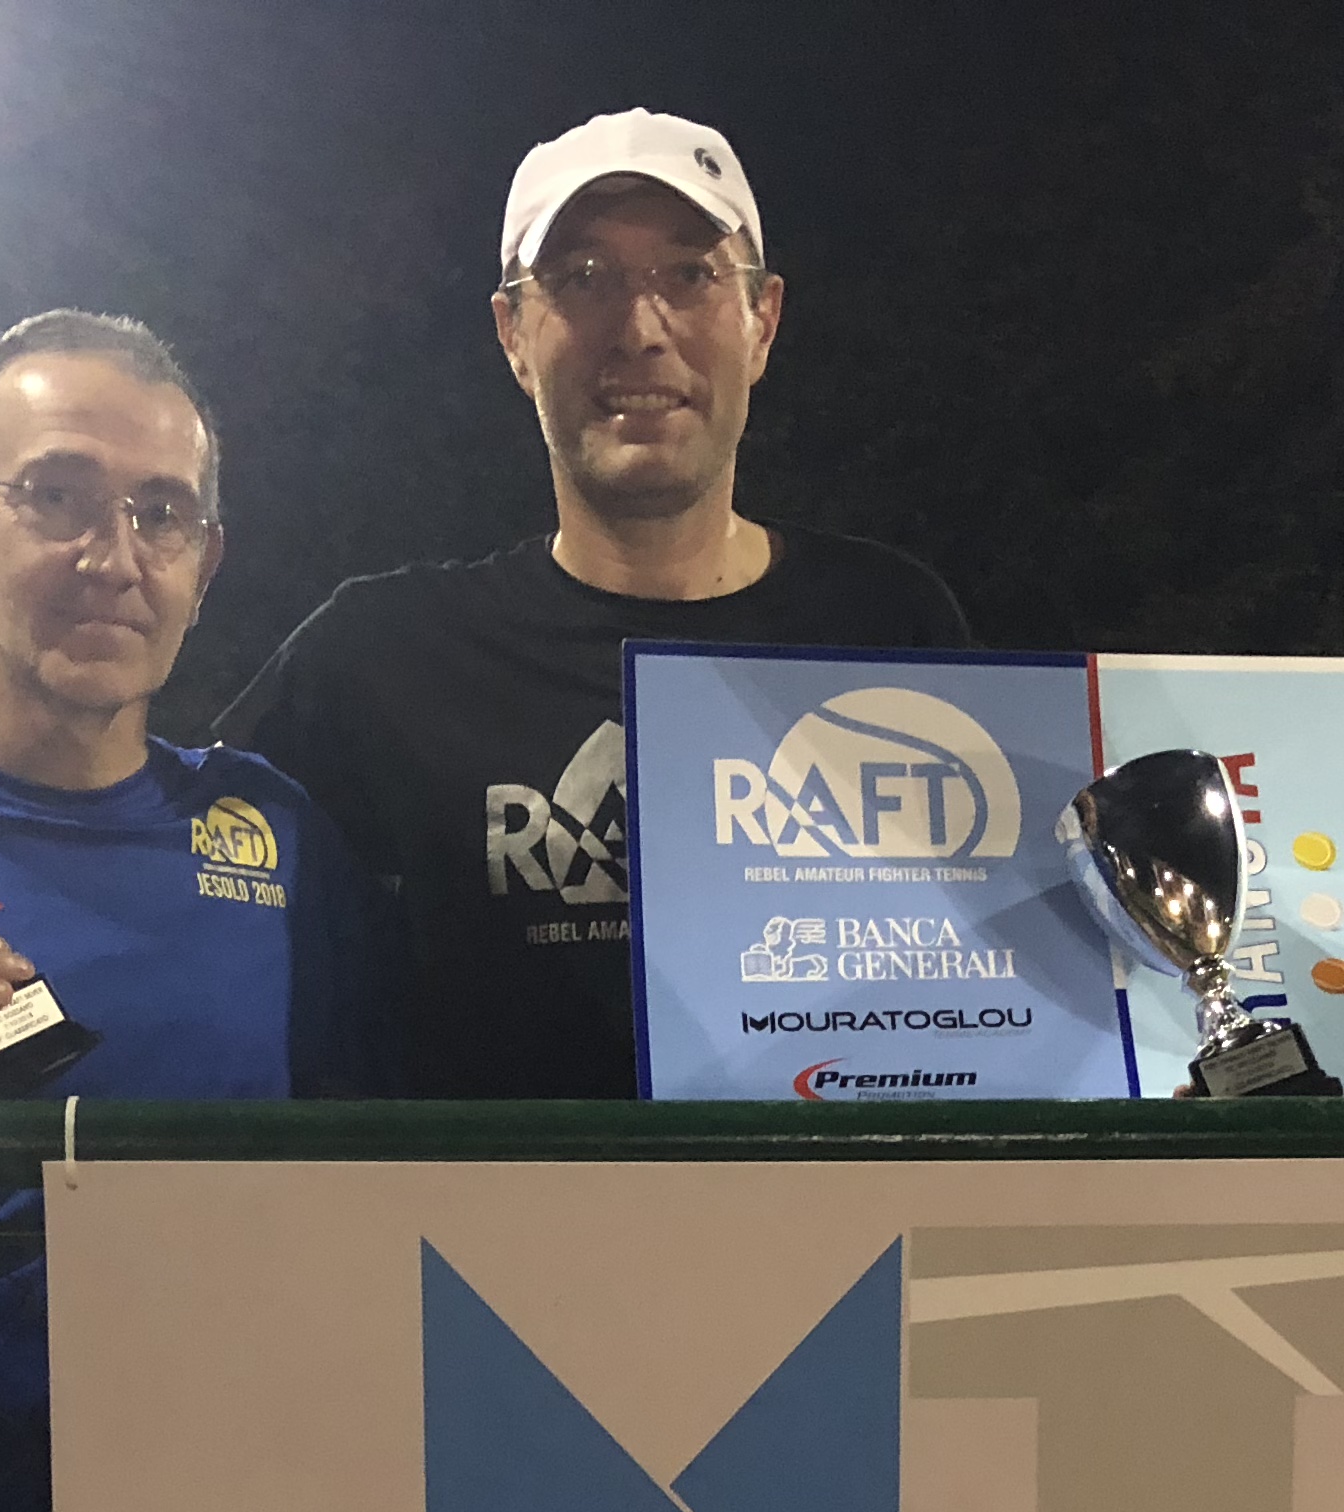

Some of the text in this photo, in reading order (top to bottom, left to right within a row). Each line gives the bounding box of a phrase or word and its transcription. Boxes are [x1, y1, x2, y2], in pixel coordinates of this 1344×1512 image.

[714, 759, 960, 845] RAFT
[191, 816, 262, 862] RAFT
[197, 872, 287, 908] JESOLO 2018
[745, 867, 987, 882] REBEL AMATEUR FIGHTER TENNIS
[527, 922, 582, 944] REBEL
[835, 917, 963, 949] BANCA
[836, 949, 1018, 981] GENERALI
[741, 1007, 1033, 1033] MOURATOGLOU
[814, 1069, 978, 1089] Premium
